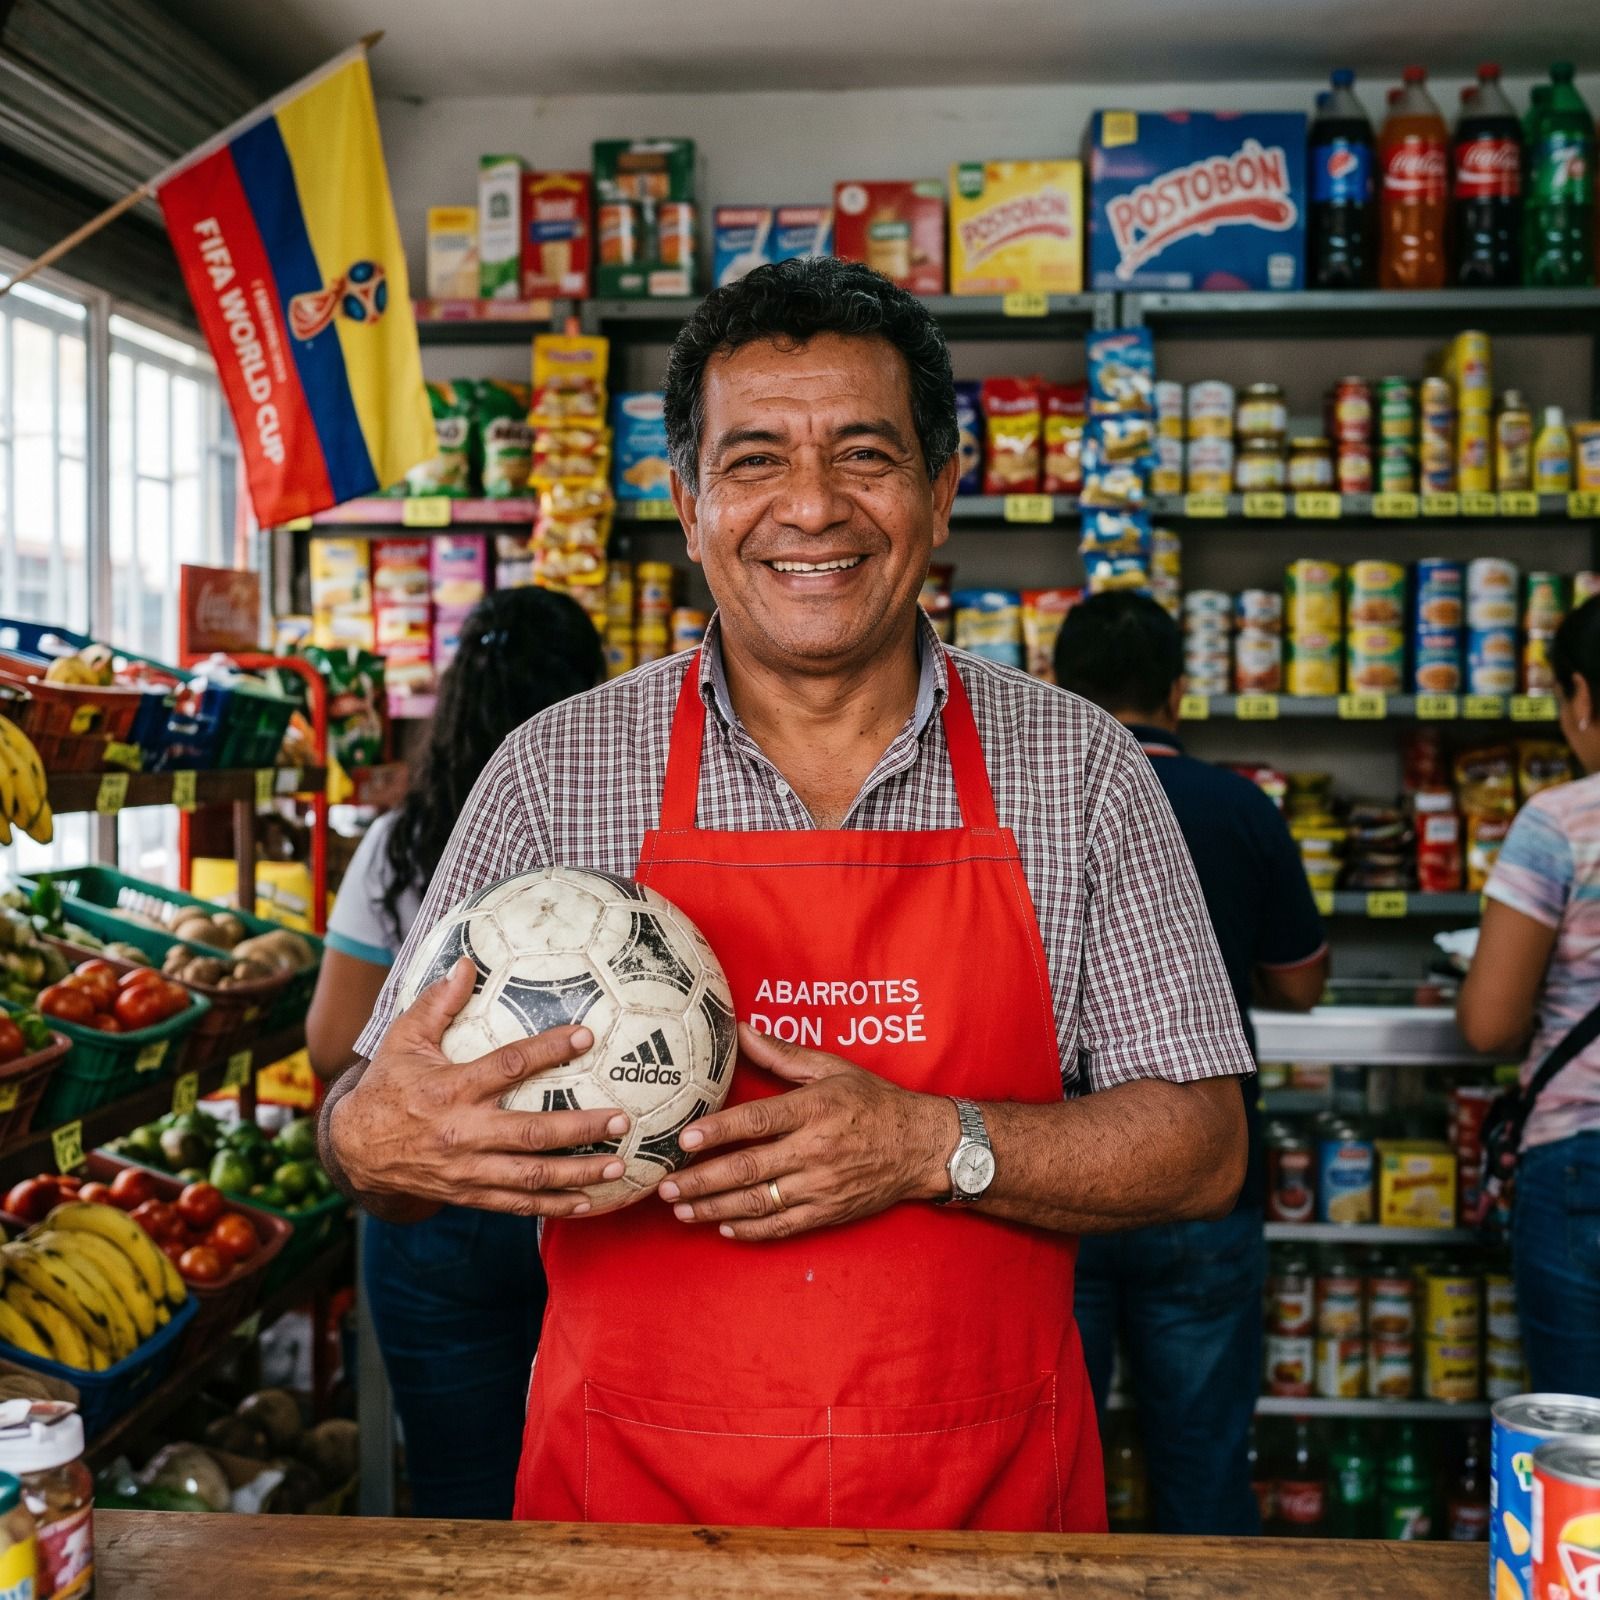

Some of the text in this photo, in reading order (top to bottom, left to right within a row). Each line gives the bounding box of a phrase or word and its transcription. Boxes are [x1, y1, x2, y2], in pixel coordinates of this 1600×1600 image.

[193, 217, 236, 291] FIFA
[219, 287, 272, 404] WORLD
[255, 403, 286, 465] CUP
[754, 978, 920, 1006] ABARROTES
[750, 1003, 927, 1047] DON JOSÉ
[609, 1062, 682, 1086] adidas
